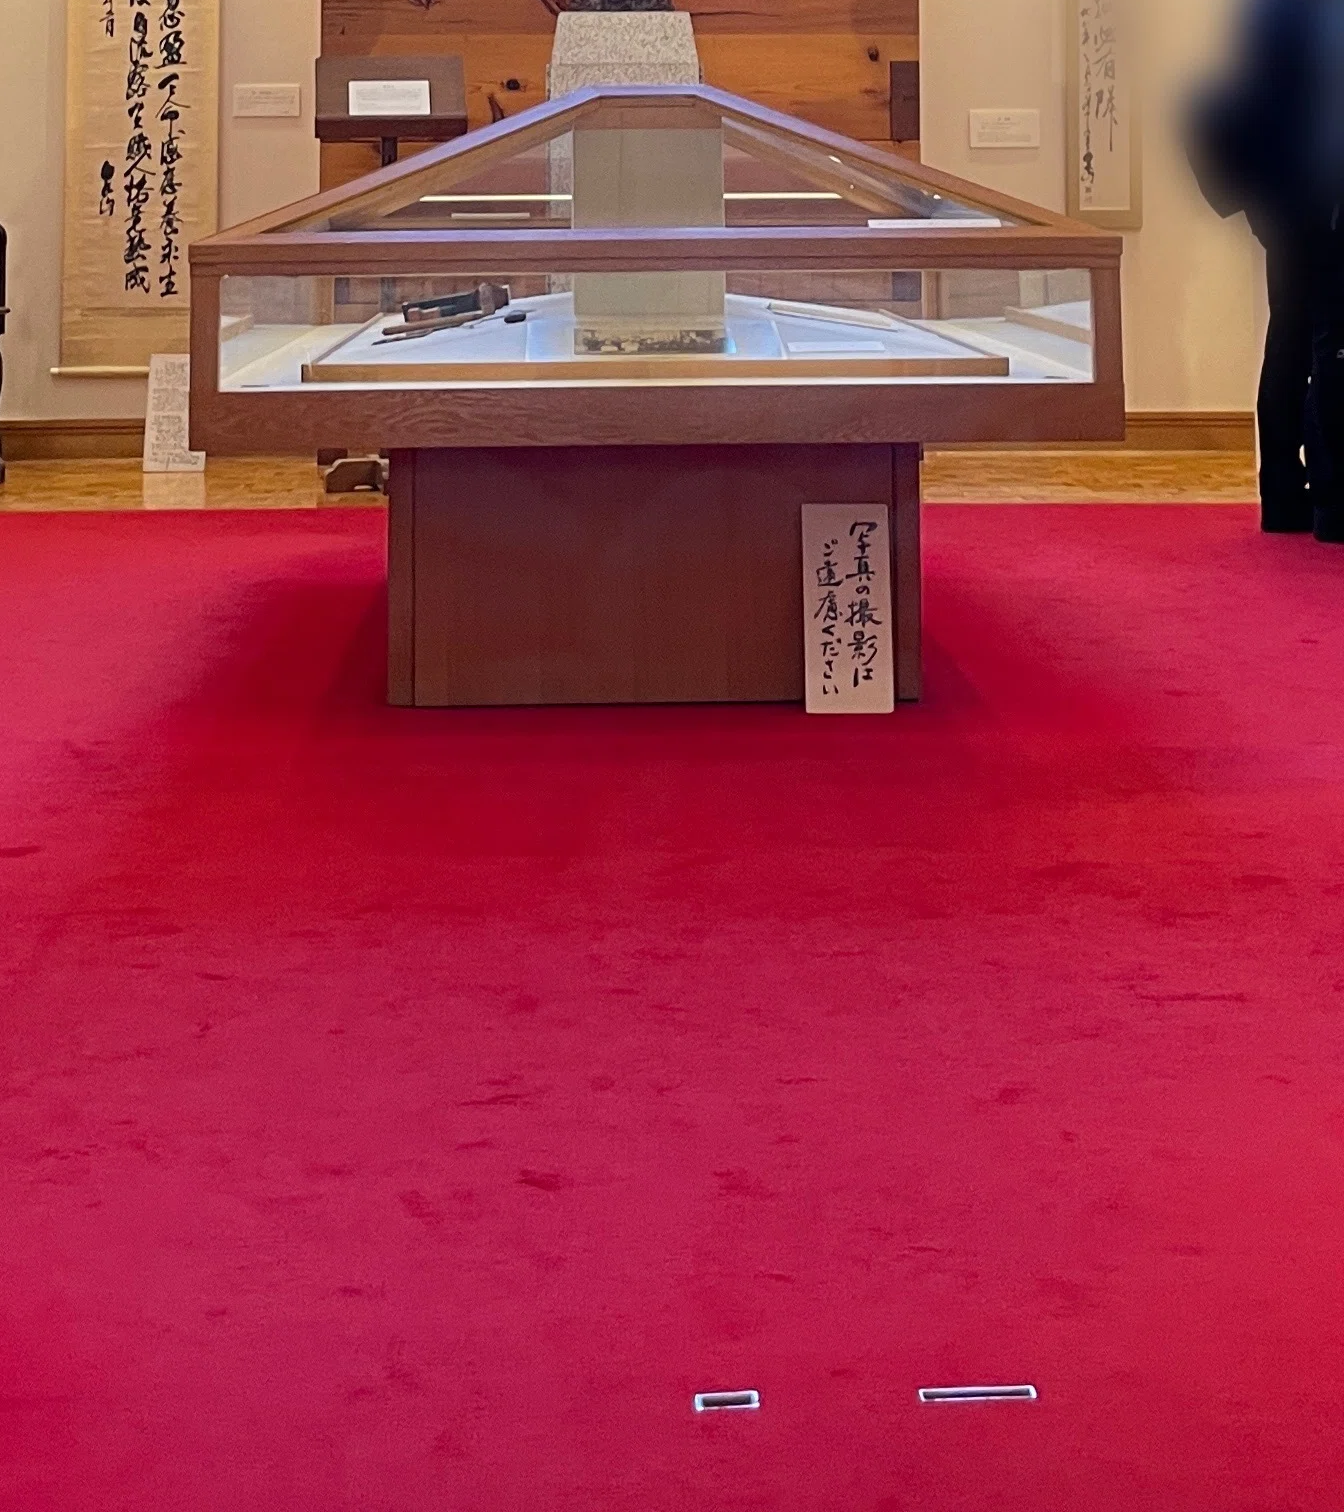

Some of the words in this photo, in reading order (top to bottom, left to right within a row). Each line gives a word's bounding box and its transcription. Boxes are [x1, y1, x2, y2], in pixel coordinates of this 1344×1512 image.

[814, 538, 843, 695] ご遠慮ください
[844, 521, 882, 687] 写真の撮影は
